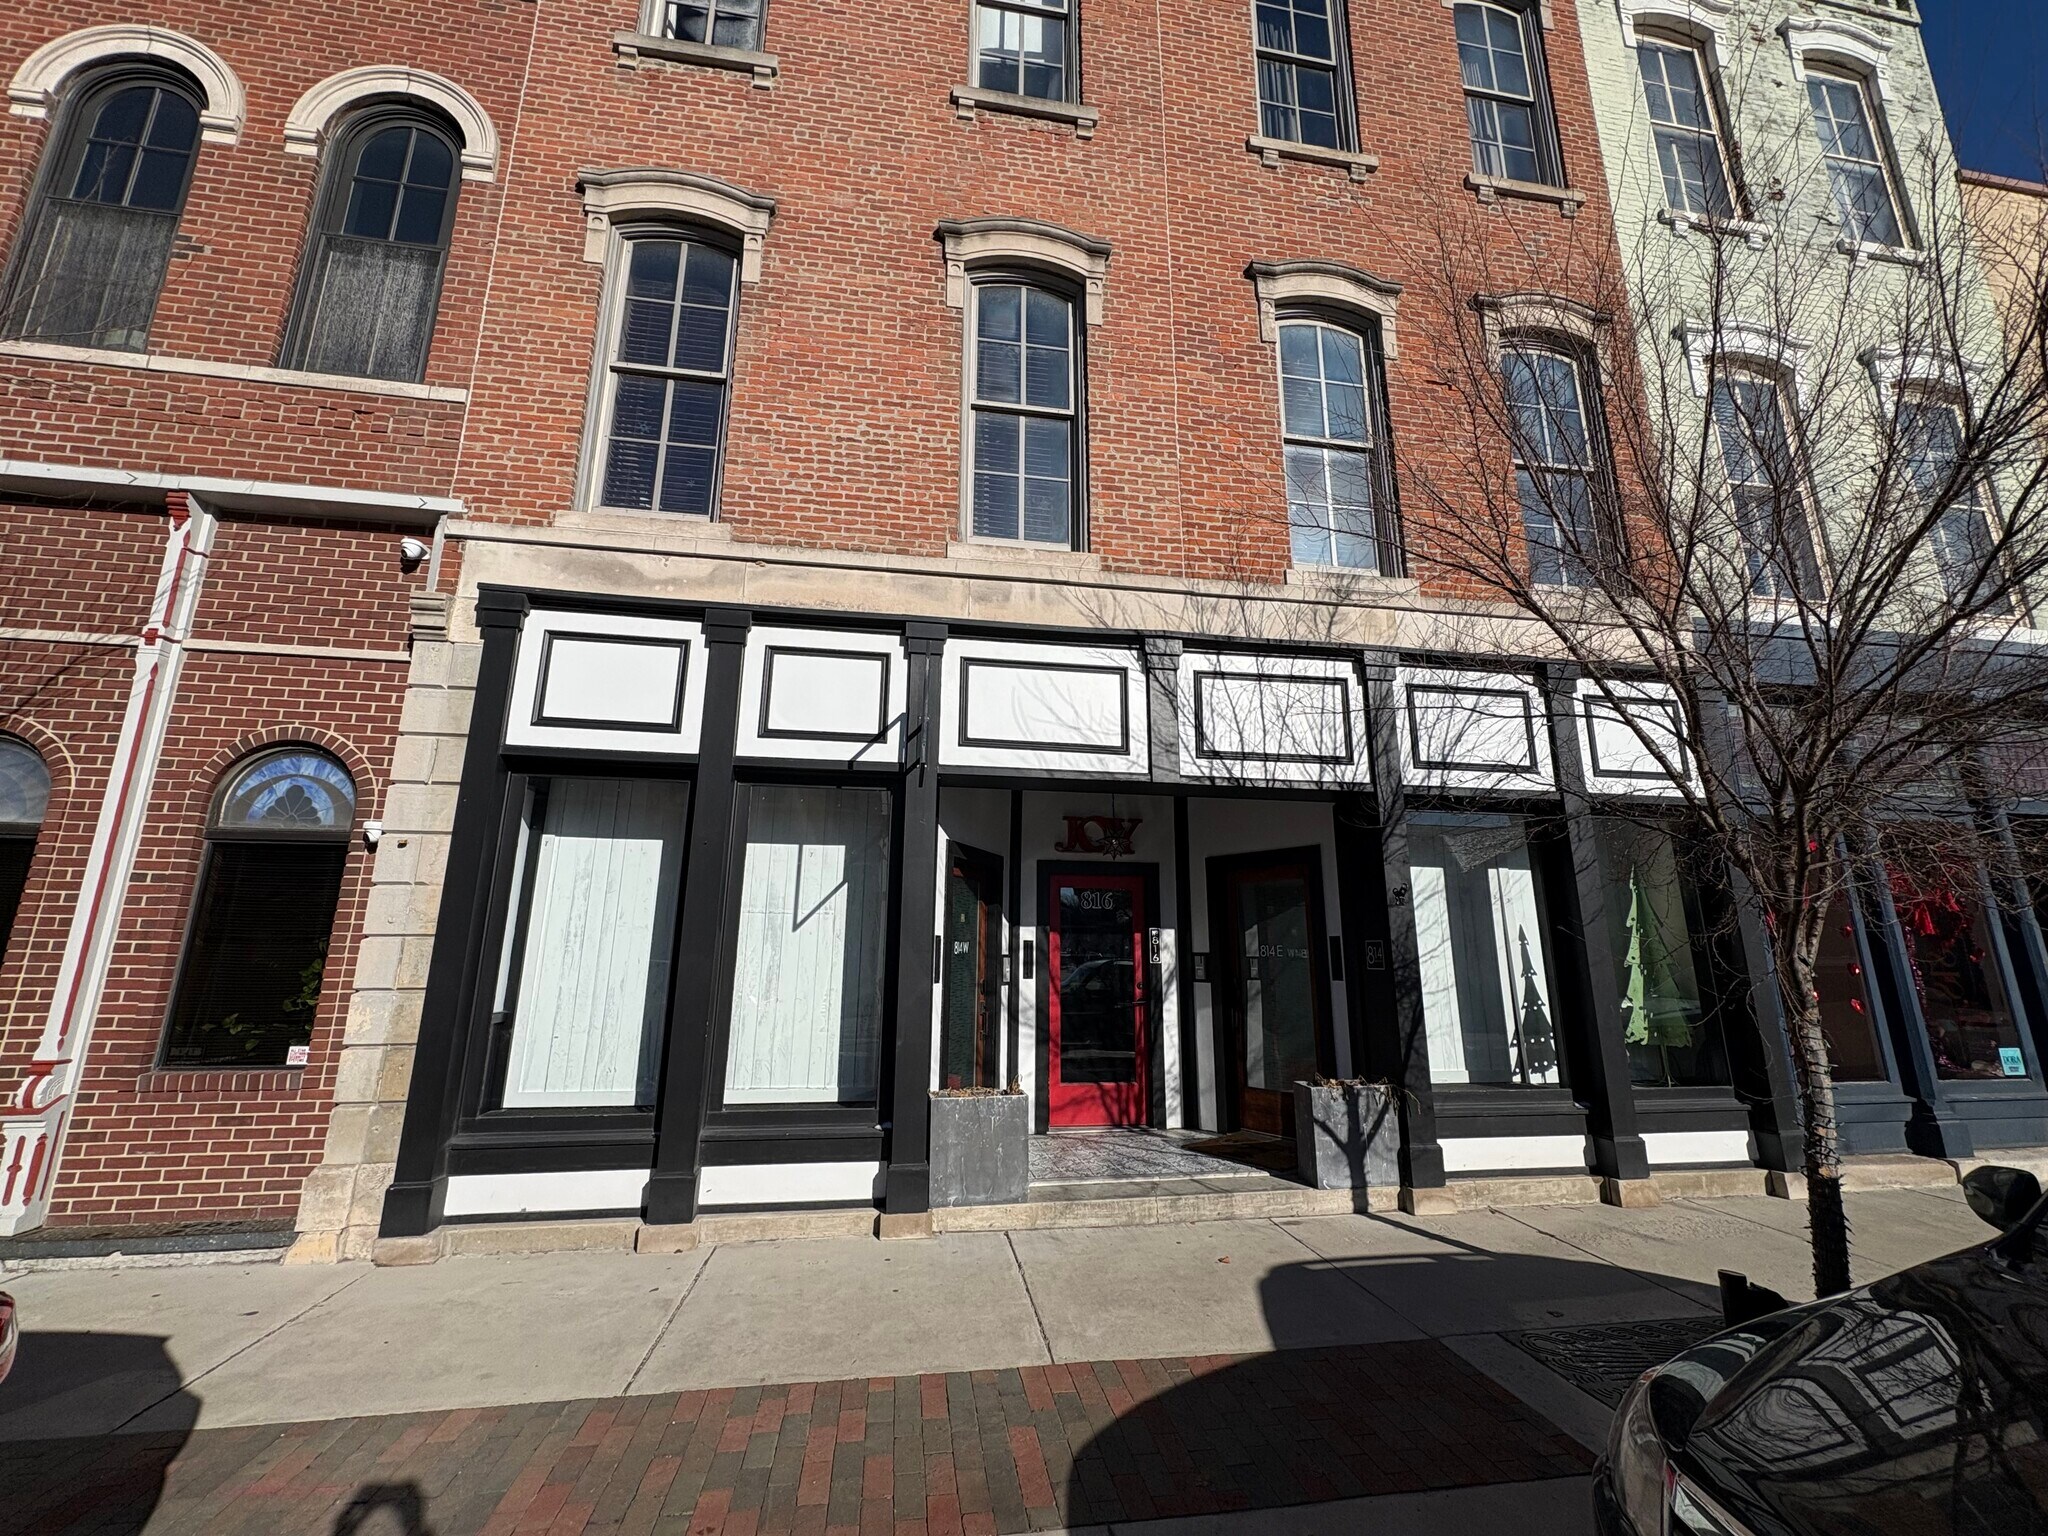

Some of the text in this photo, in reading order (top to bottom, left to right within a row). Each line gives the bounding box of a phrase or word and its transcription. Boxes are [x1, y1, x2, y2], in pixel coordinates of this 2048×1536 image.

[1055, 816, 1143, 855] JOY
[1080, 891, 1114, 910] 816
[1151, 936, 1160, 962] 816
[1367, 945, 1383, 965] 814
[2002, 1055, 2021, 1066] DORA
